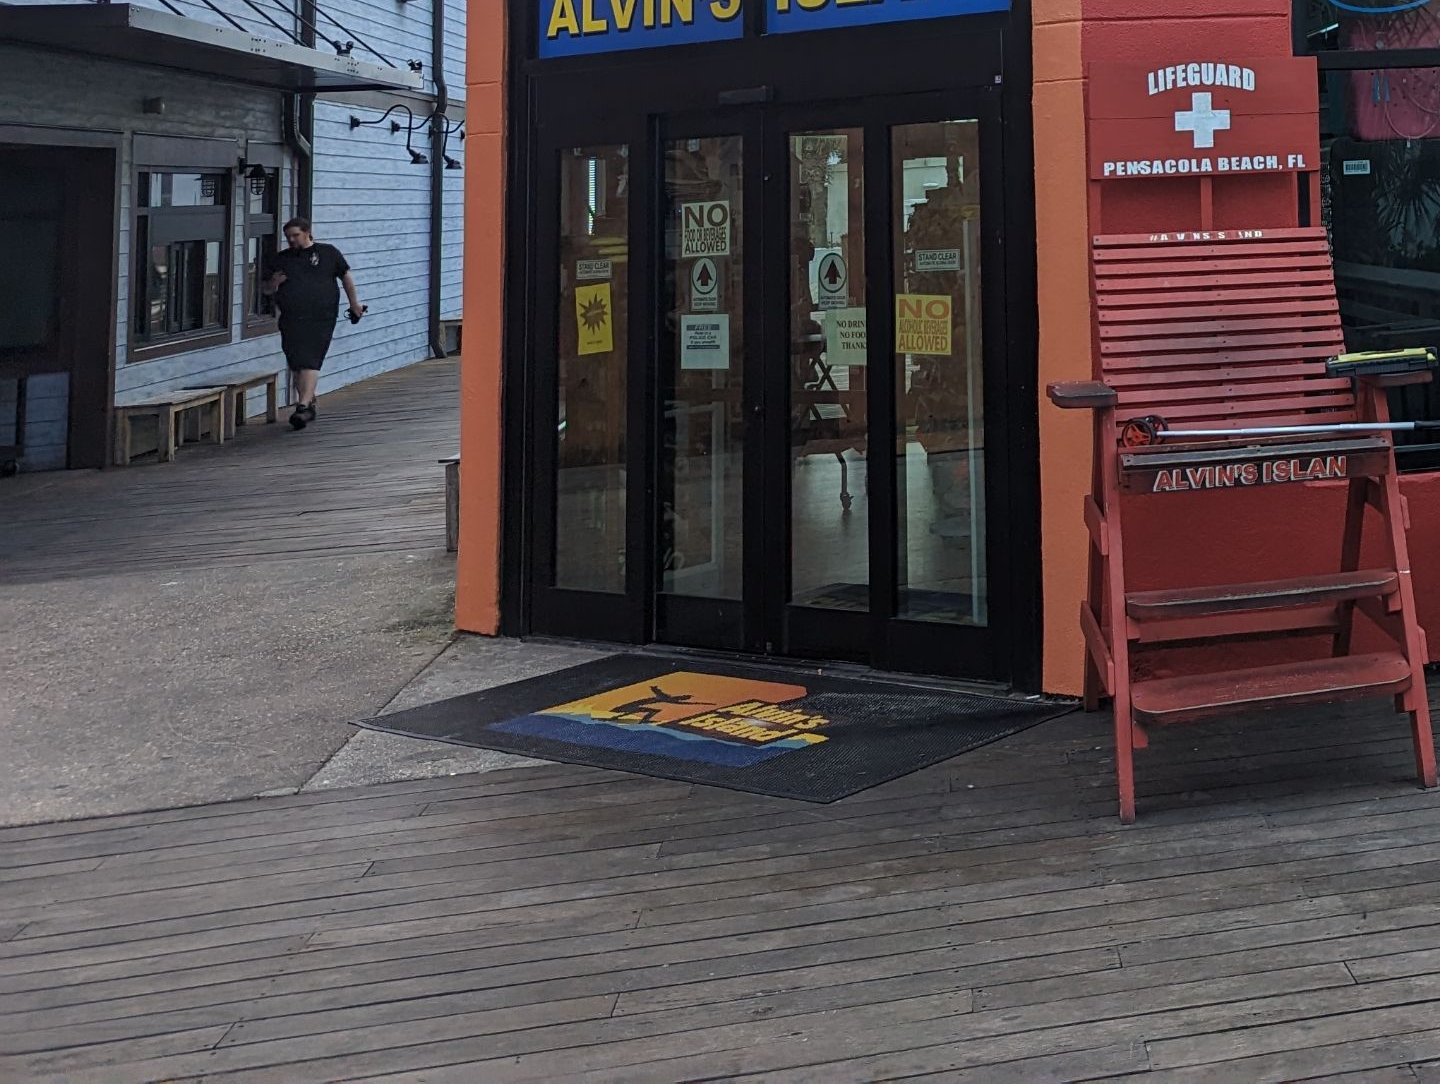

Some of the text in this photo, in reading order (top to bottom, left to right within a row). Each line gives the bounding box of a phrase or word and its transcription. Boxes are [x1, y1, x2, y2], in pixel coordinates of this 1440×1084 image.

[1148, 62, 1255, 95] LIFEGUARD
[1103, 154, 1306, 176] PENSACOLA BEACH, FL
[685, 204, 729, 228] NO
[685, 241, 727, 254] ALLOWED
[918, 252, 957, 261] STAND CLEAR
[899, 299, 949, 319] NO
[836, 320, 847, 328] NO
[899, 334, 948, 351] ALLOWED
[1153, 455, 1347, 492] ALVIN'S ISLAN
